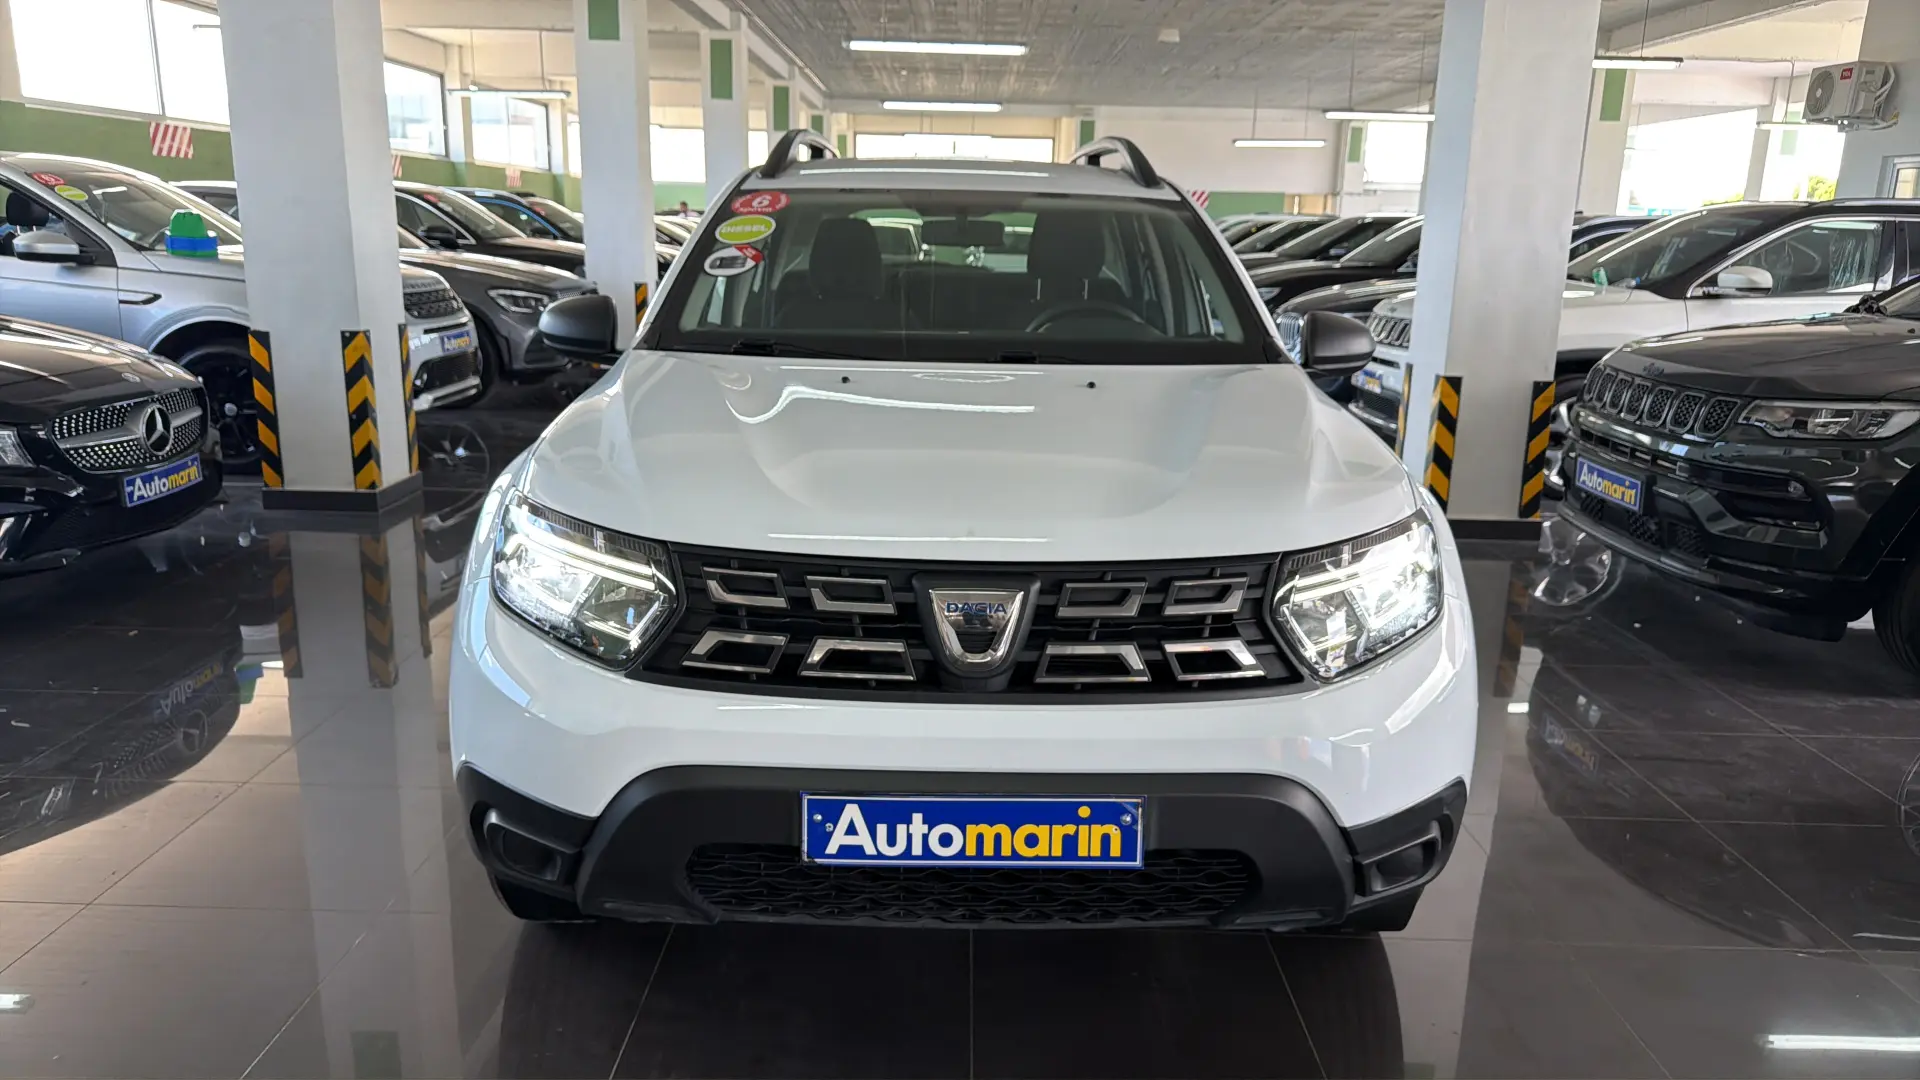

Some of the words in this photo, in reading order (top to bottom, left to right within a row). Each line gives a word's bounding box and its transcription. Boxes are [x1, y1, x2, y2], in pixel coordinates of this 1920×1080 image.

[752, 195, 772, 208] 6
[133, 460, 199, 501] Automarin
[1579, 463, 1637, 505] Automarin
[945, 602, 1007, 615] DACIA
[824, 803, 1122, 858] Automarin
